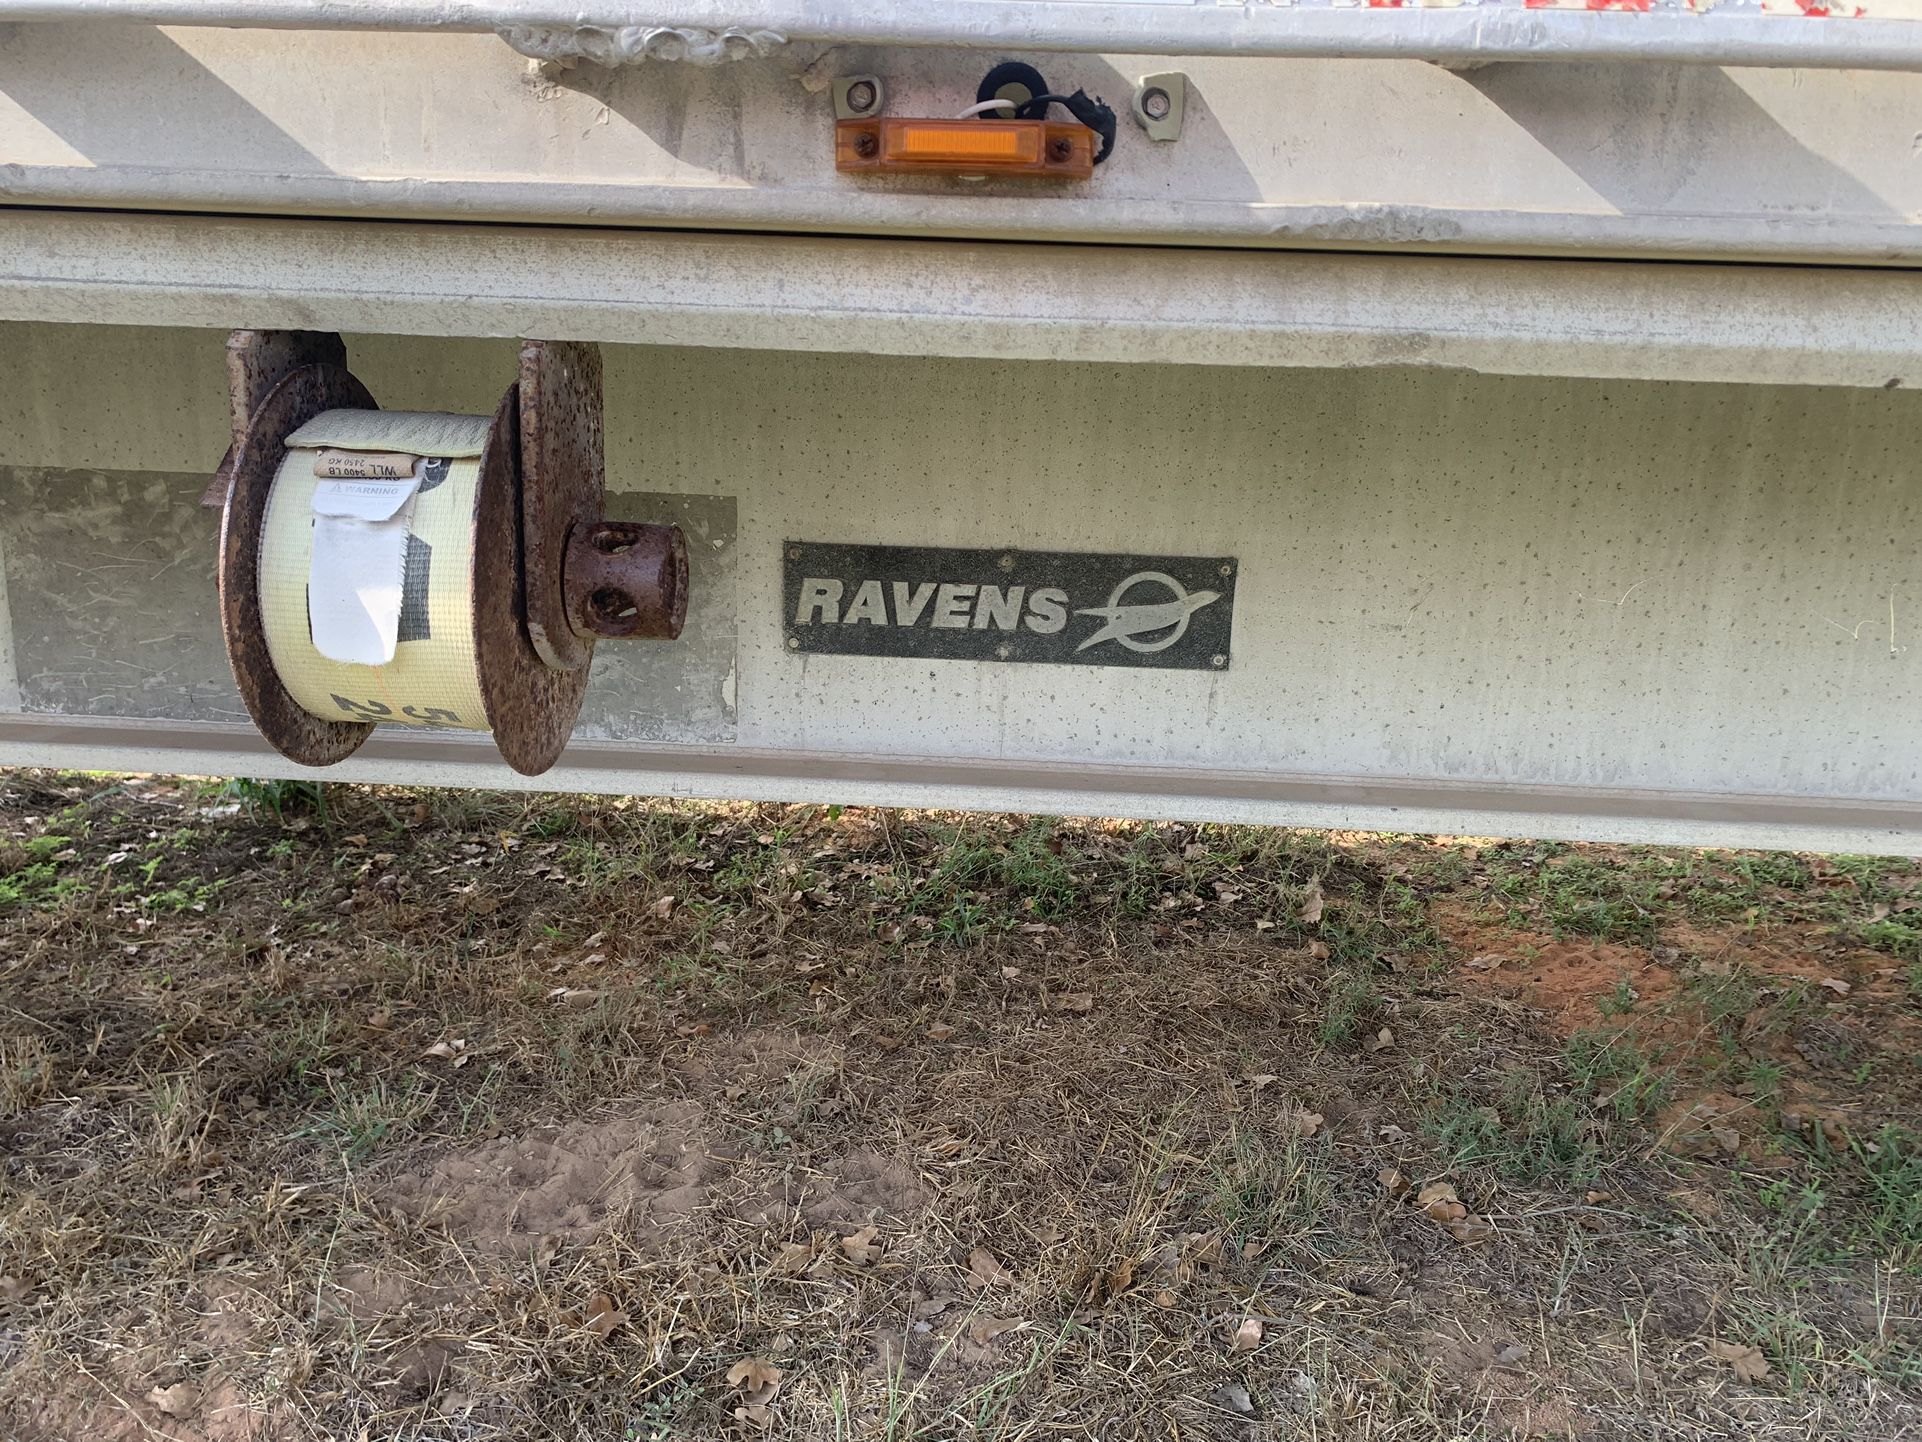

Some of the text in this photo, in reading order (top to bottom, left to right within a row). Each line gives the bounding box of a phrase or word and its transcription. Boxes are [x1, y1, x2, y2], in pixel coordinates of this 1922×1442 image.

[328, 467, 342, 475] LB
[369, 464, 397, 476] WLL
[345, 485, 400, 495] WARNING
[795, 577, 1068, 635] RAVENS
